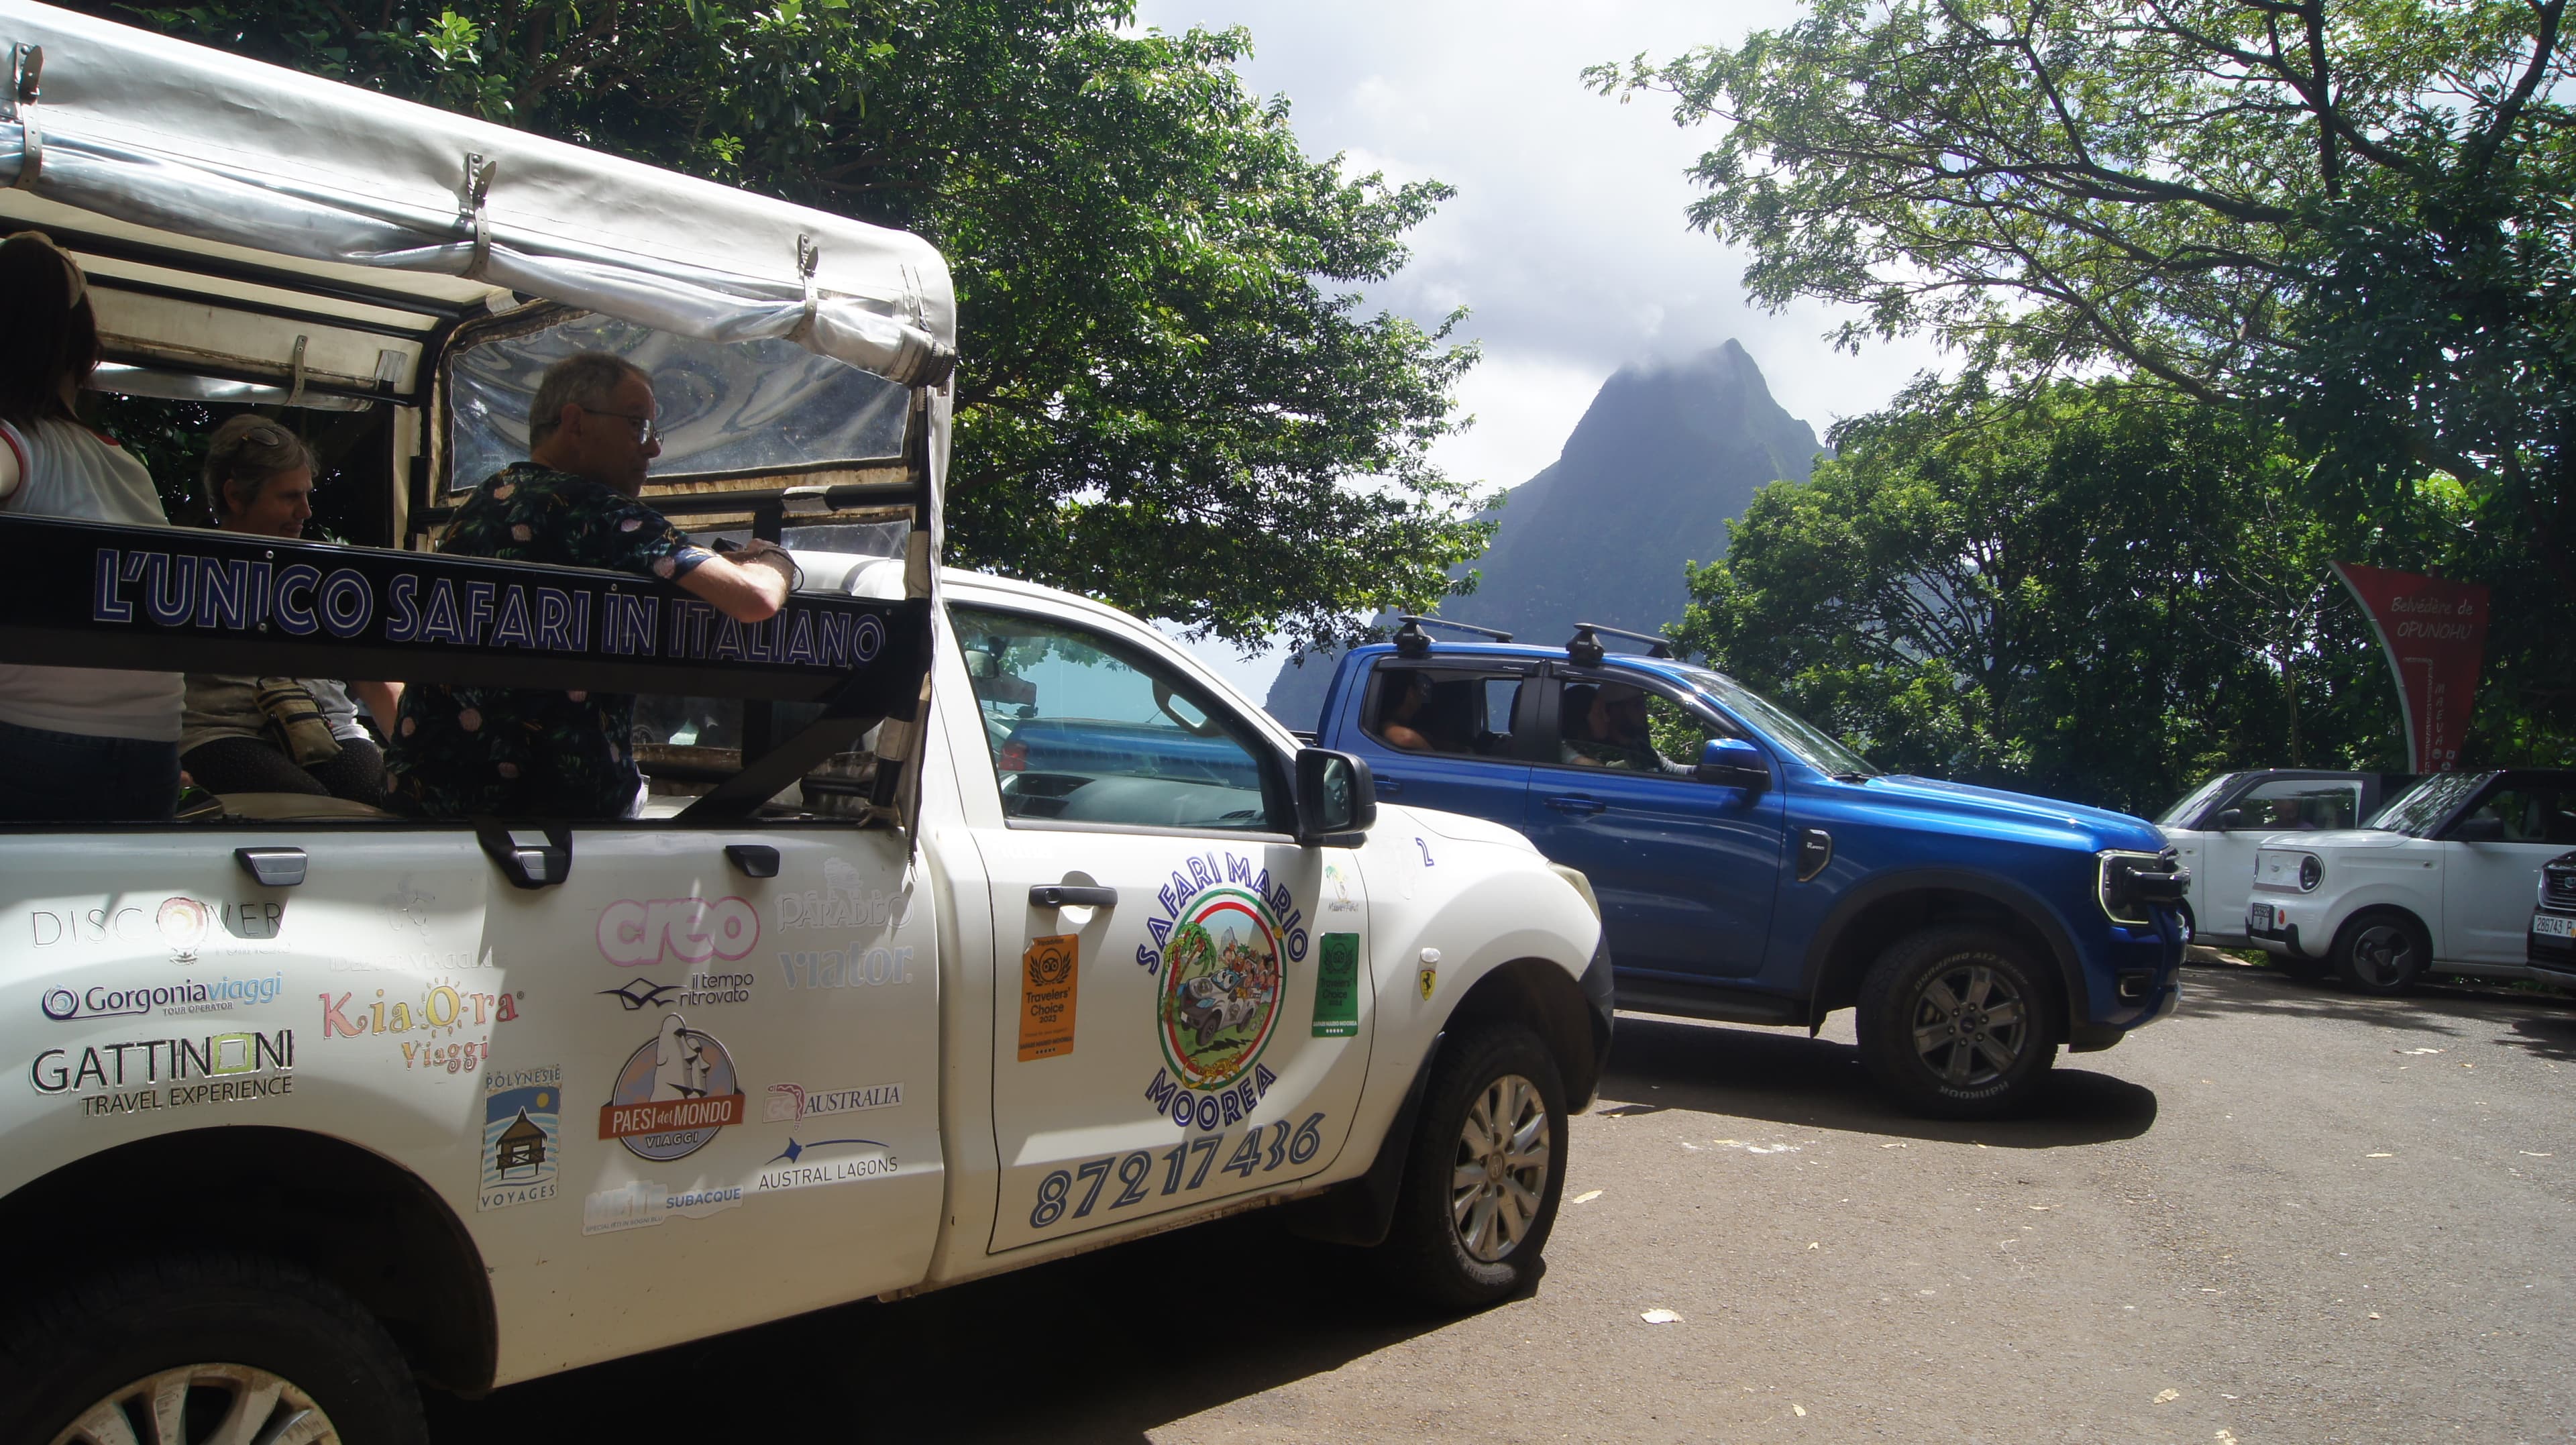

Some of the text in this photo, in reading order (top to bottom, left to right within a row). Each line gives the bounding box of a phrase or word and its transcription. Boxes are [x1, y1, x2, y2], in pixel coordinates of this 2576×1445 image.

[93, 548, 885, 671] L'UNICO SAFARI IN ITALIANO
[2457, 598, 2474, 615] de
[2397, 621, 2473, 639] OPUNOHU
[1414, 837, 1436, 868] 2
[1136, 851, 1308, 976] SAFARI MARIO
[692, 973, 755, 992] il tempo
[680, 989, 750, 1007] ritrovato
[1026, 987, 1071, 1004] Travelers'
[162, 1002, 234, 1017] TOUR OPERATOR
[1030, 1002, 1064, 1016] Choice
[1040, 1014, 1057, 1024] 2023
[402, 1035, 490, 1074] Viaggi
[84, 1076, 293, 1116] TRAVEL EXPERIENCE
[804, 1086, 901, 1114] AUSTRALIA
[1144, 1063, 1277, 1131] MOOREA
[612, 1100, 732, 1133] PAESI del MONDO
[645, 1132, 698, 1148] VIAGGI
[759, 1157, 898, 1191] AUSTRAL LAGONS
[482, 1185, 555, 1207] VOYAGES
[665, 1188, 741, 1209] SUBACQUE
